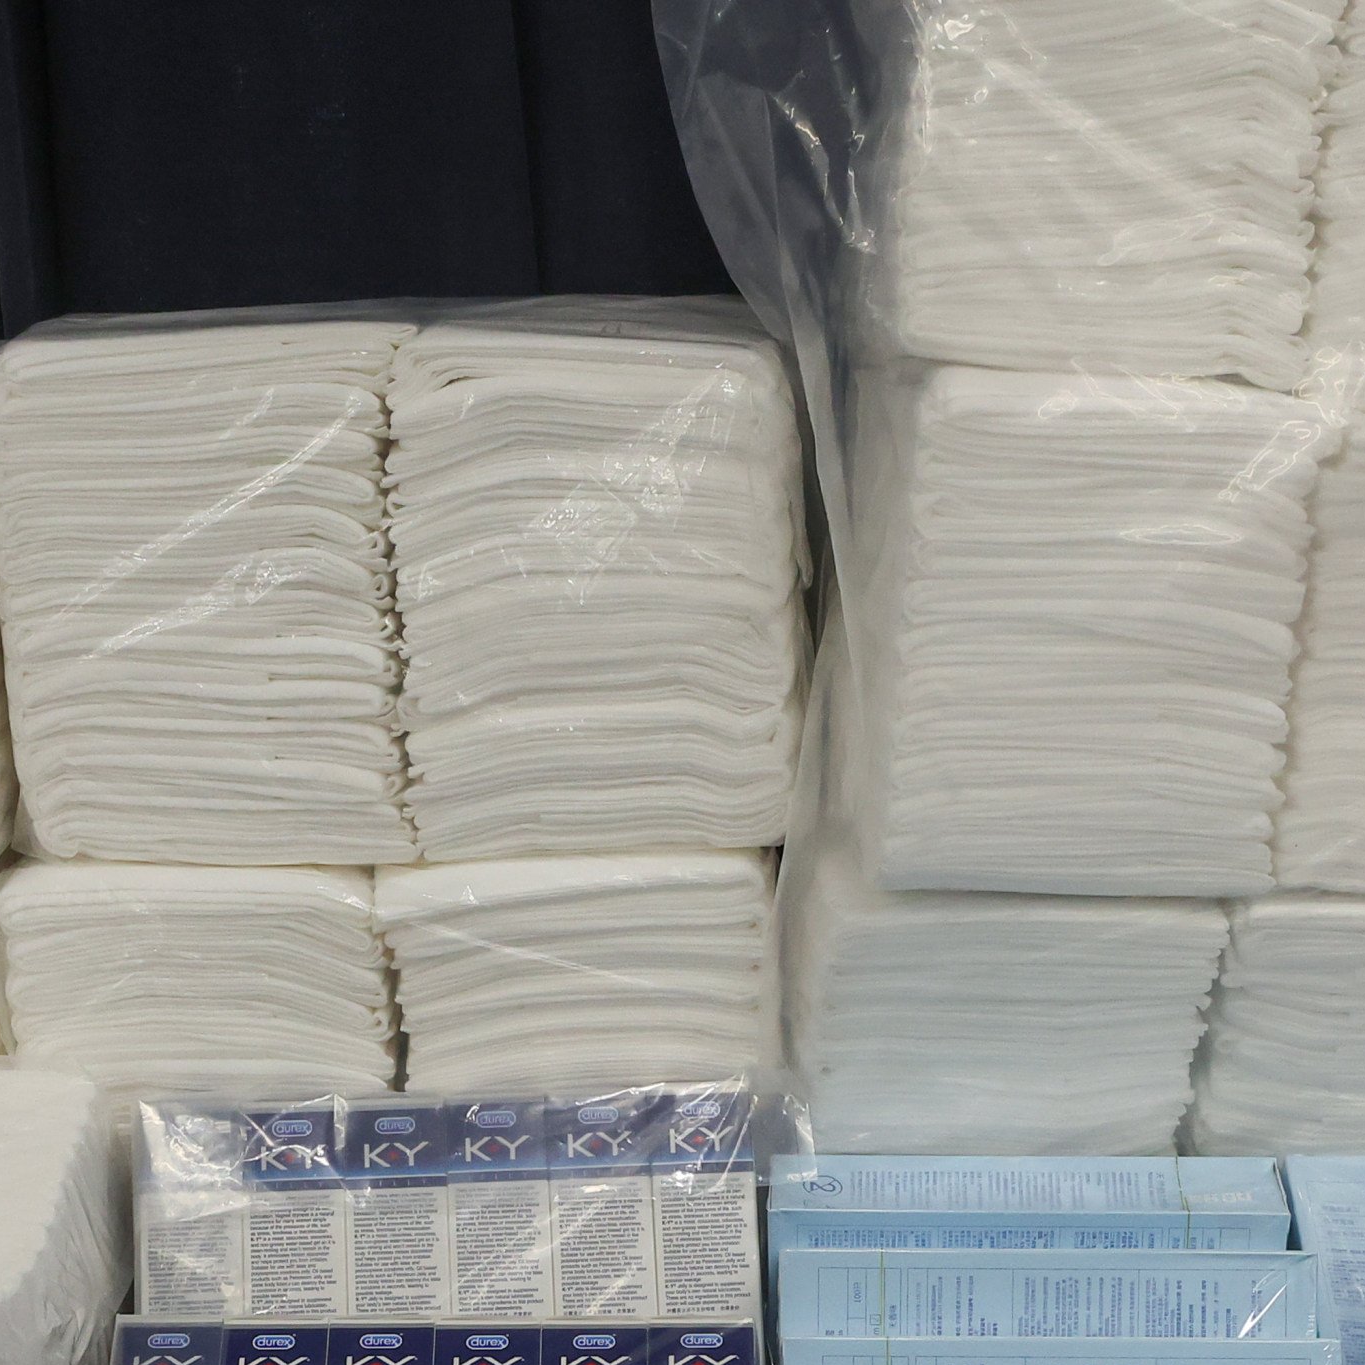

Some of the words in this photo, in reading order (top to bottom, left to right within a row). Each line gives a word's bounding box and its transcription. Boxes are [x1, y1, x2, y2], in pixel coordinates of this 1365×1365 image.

[151, 1334, 187, 1348] durex
[255, 1335, 292, 1349] durex
[363, 1335, 400, 1348] durex
[469, 1335, 506, 1349] durex
[576, 1335, 613, 1349] durex
[683, 1334, 720, 1348] durex
